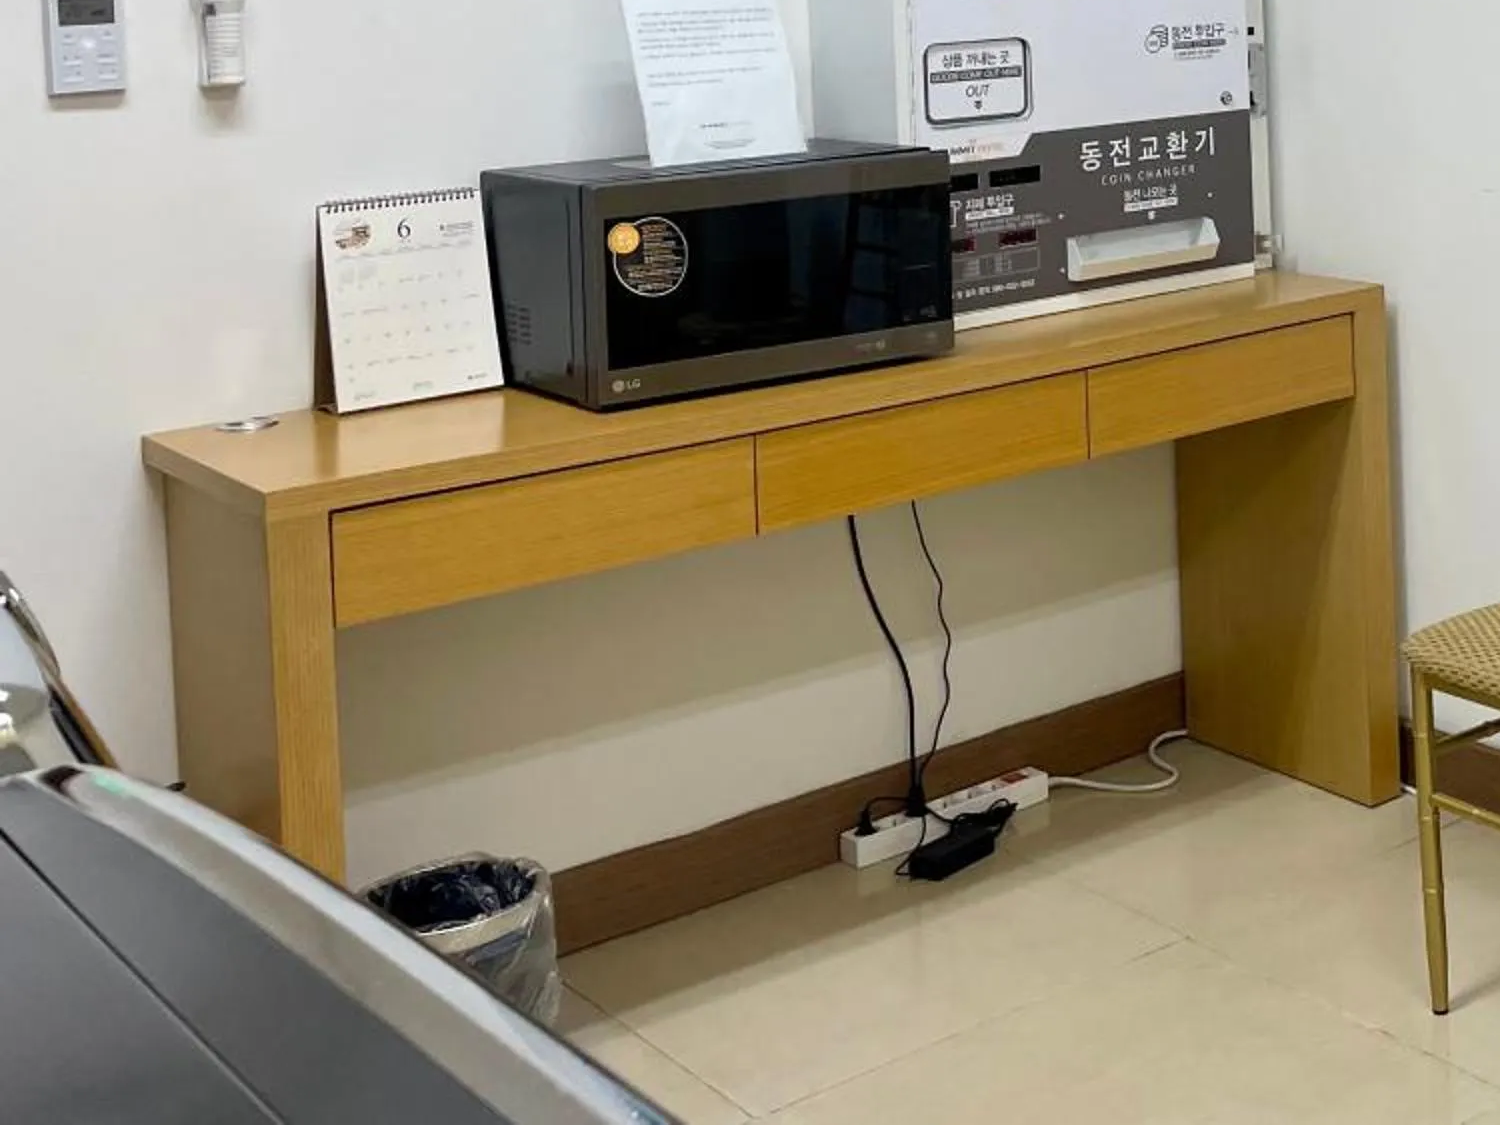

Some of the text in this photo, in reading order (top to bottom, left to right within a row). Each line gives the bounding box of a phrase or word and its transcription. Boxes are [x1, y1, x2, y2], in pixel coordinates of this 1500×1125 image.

[966, 84, 989, 97] OUT
[1080, 126, 1215, 172] 동전교환기
[1101, 164, 1196, 186] COIN CHANGER
[397, 216, 412, 239] 6
[627, 379, 641, 391] LG
